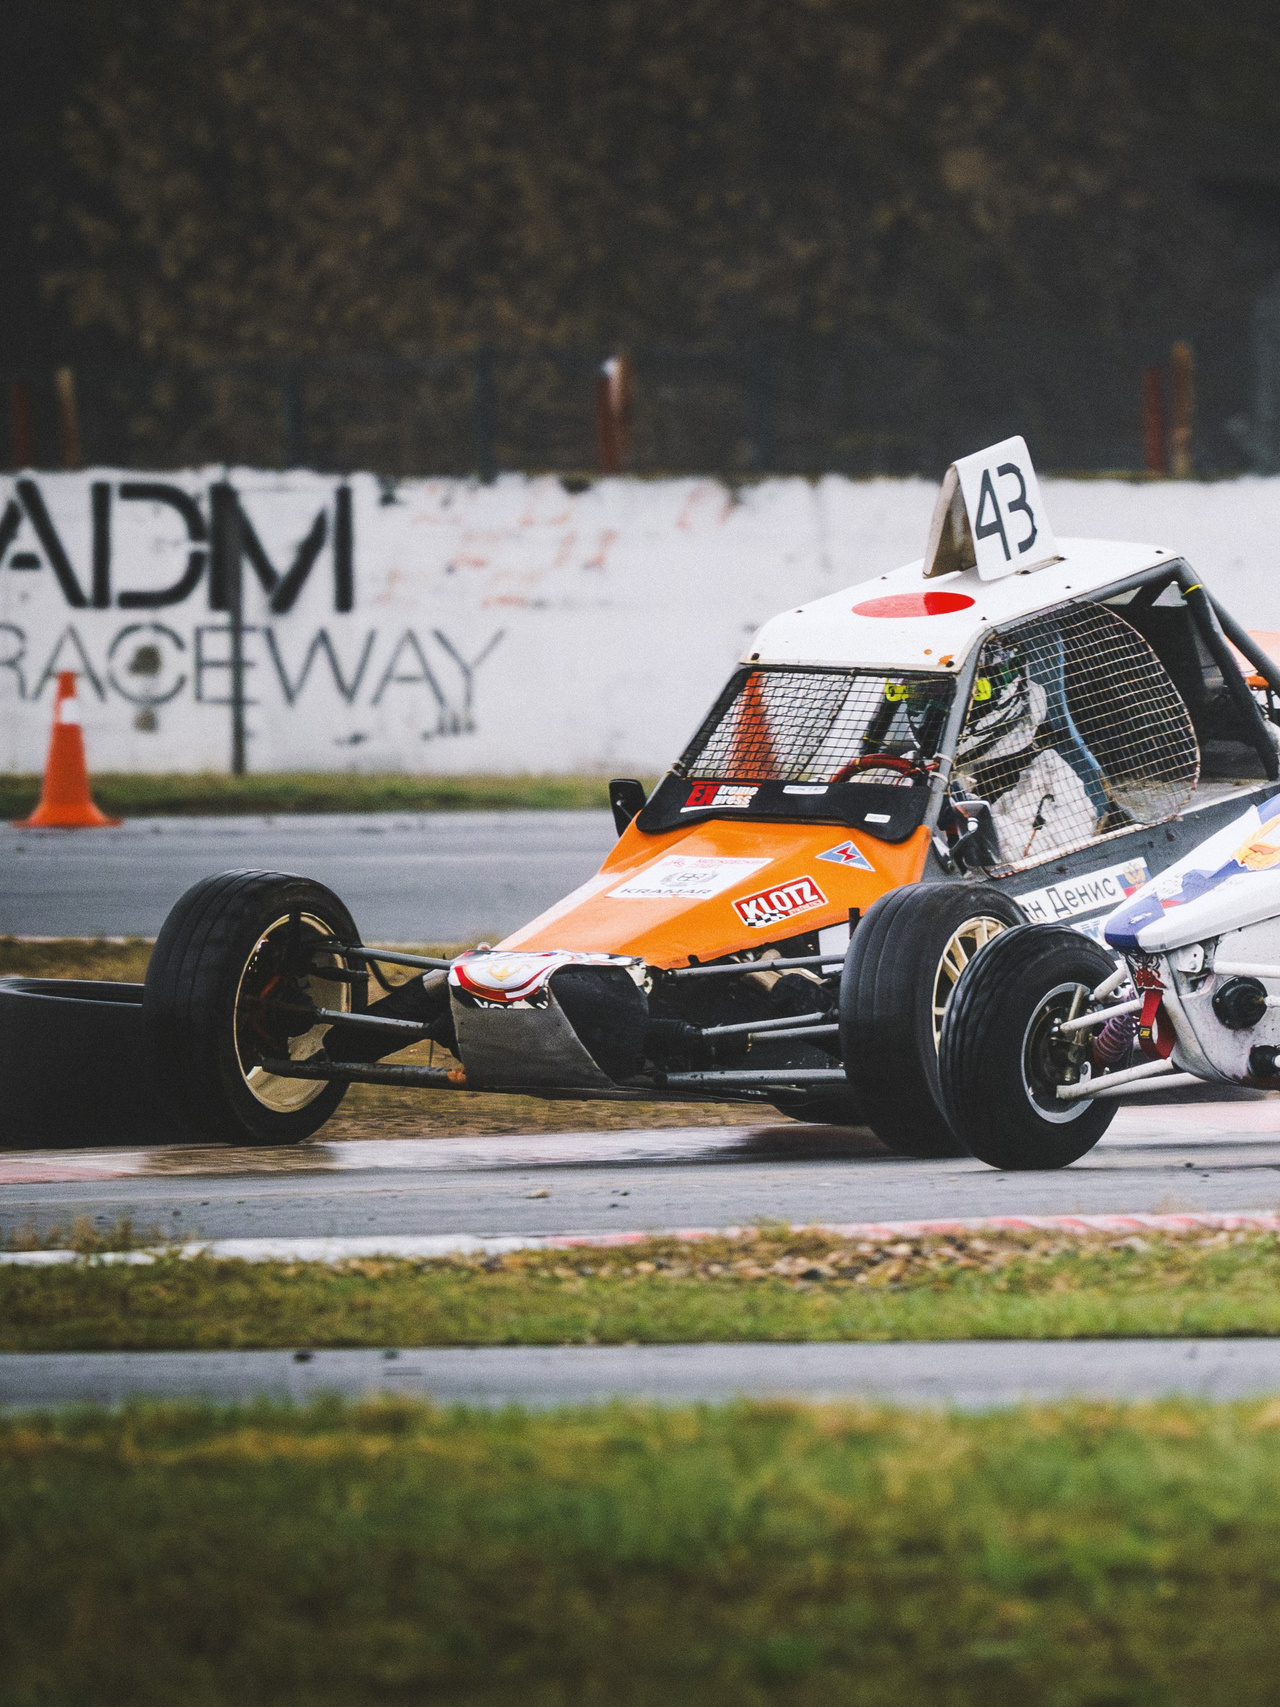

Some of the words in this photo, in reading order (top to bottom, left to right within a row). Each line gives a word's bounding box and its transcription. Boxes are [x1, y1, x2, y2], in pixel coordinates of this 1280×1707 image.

[975, 462, 1038, 562] 43
[0, 480, 354, 614] ADM
[0, 622, 505, 708] RACEWAY
[621, 887, 712, 895] KRAMAR
[740, 880, 819, 919] KLOTZ
[1046, 877, 1117, 918] Денис
